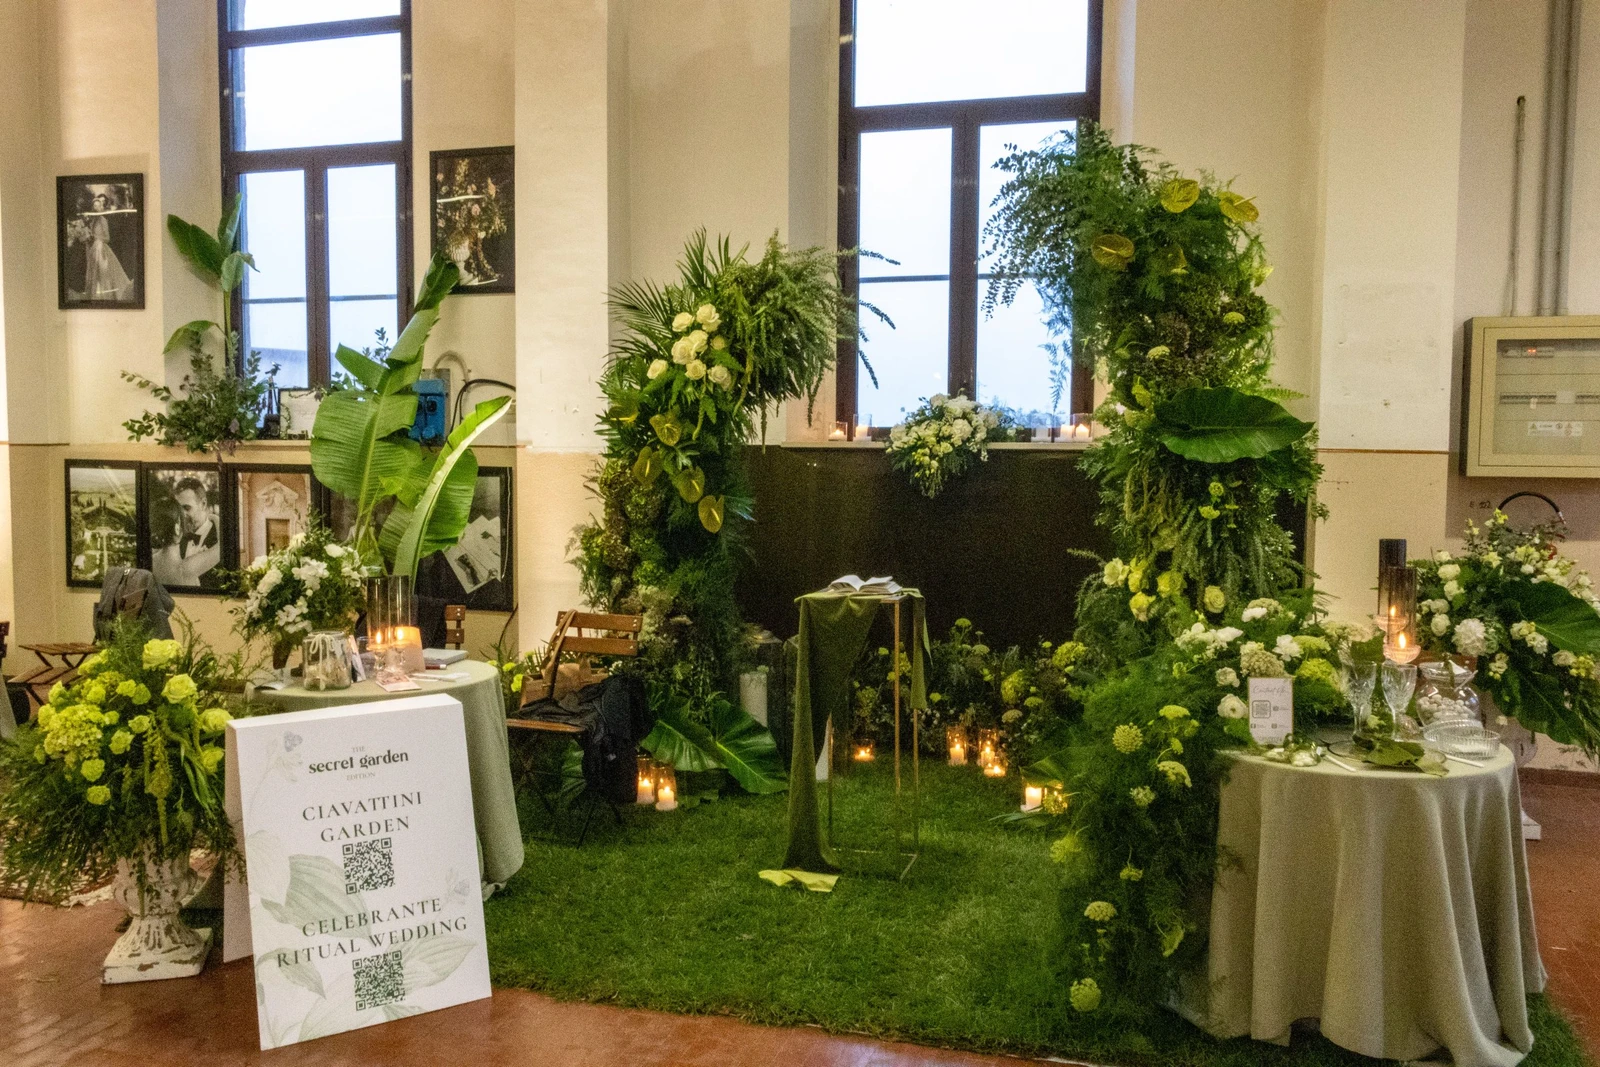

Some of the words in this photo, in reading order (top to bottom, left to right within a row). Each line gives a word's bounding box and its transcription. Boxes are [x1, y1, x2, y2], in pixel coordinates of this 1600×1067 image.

[308, 756, 354, 774] secret
[359, 749, 409, 769] garden
[351, 745, 366, 754] THE
[346, 771, 376, 781] EDITION
[302, 791, 422, 821] CIAVATTINI
[320, 816, 410, 842] GARDEN
[302, 898, 442, 937] CELEBRANTE
[277, 939, 361, 968] RITUAL
[369, 916, 467, 948] WEDDING
